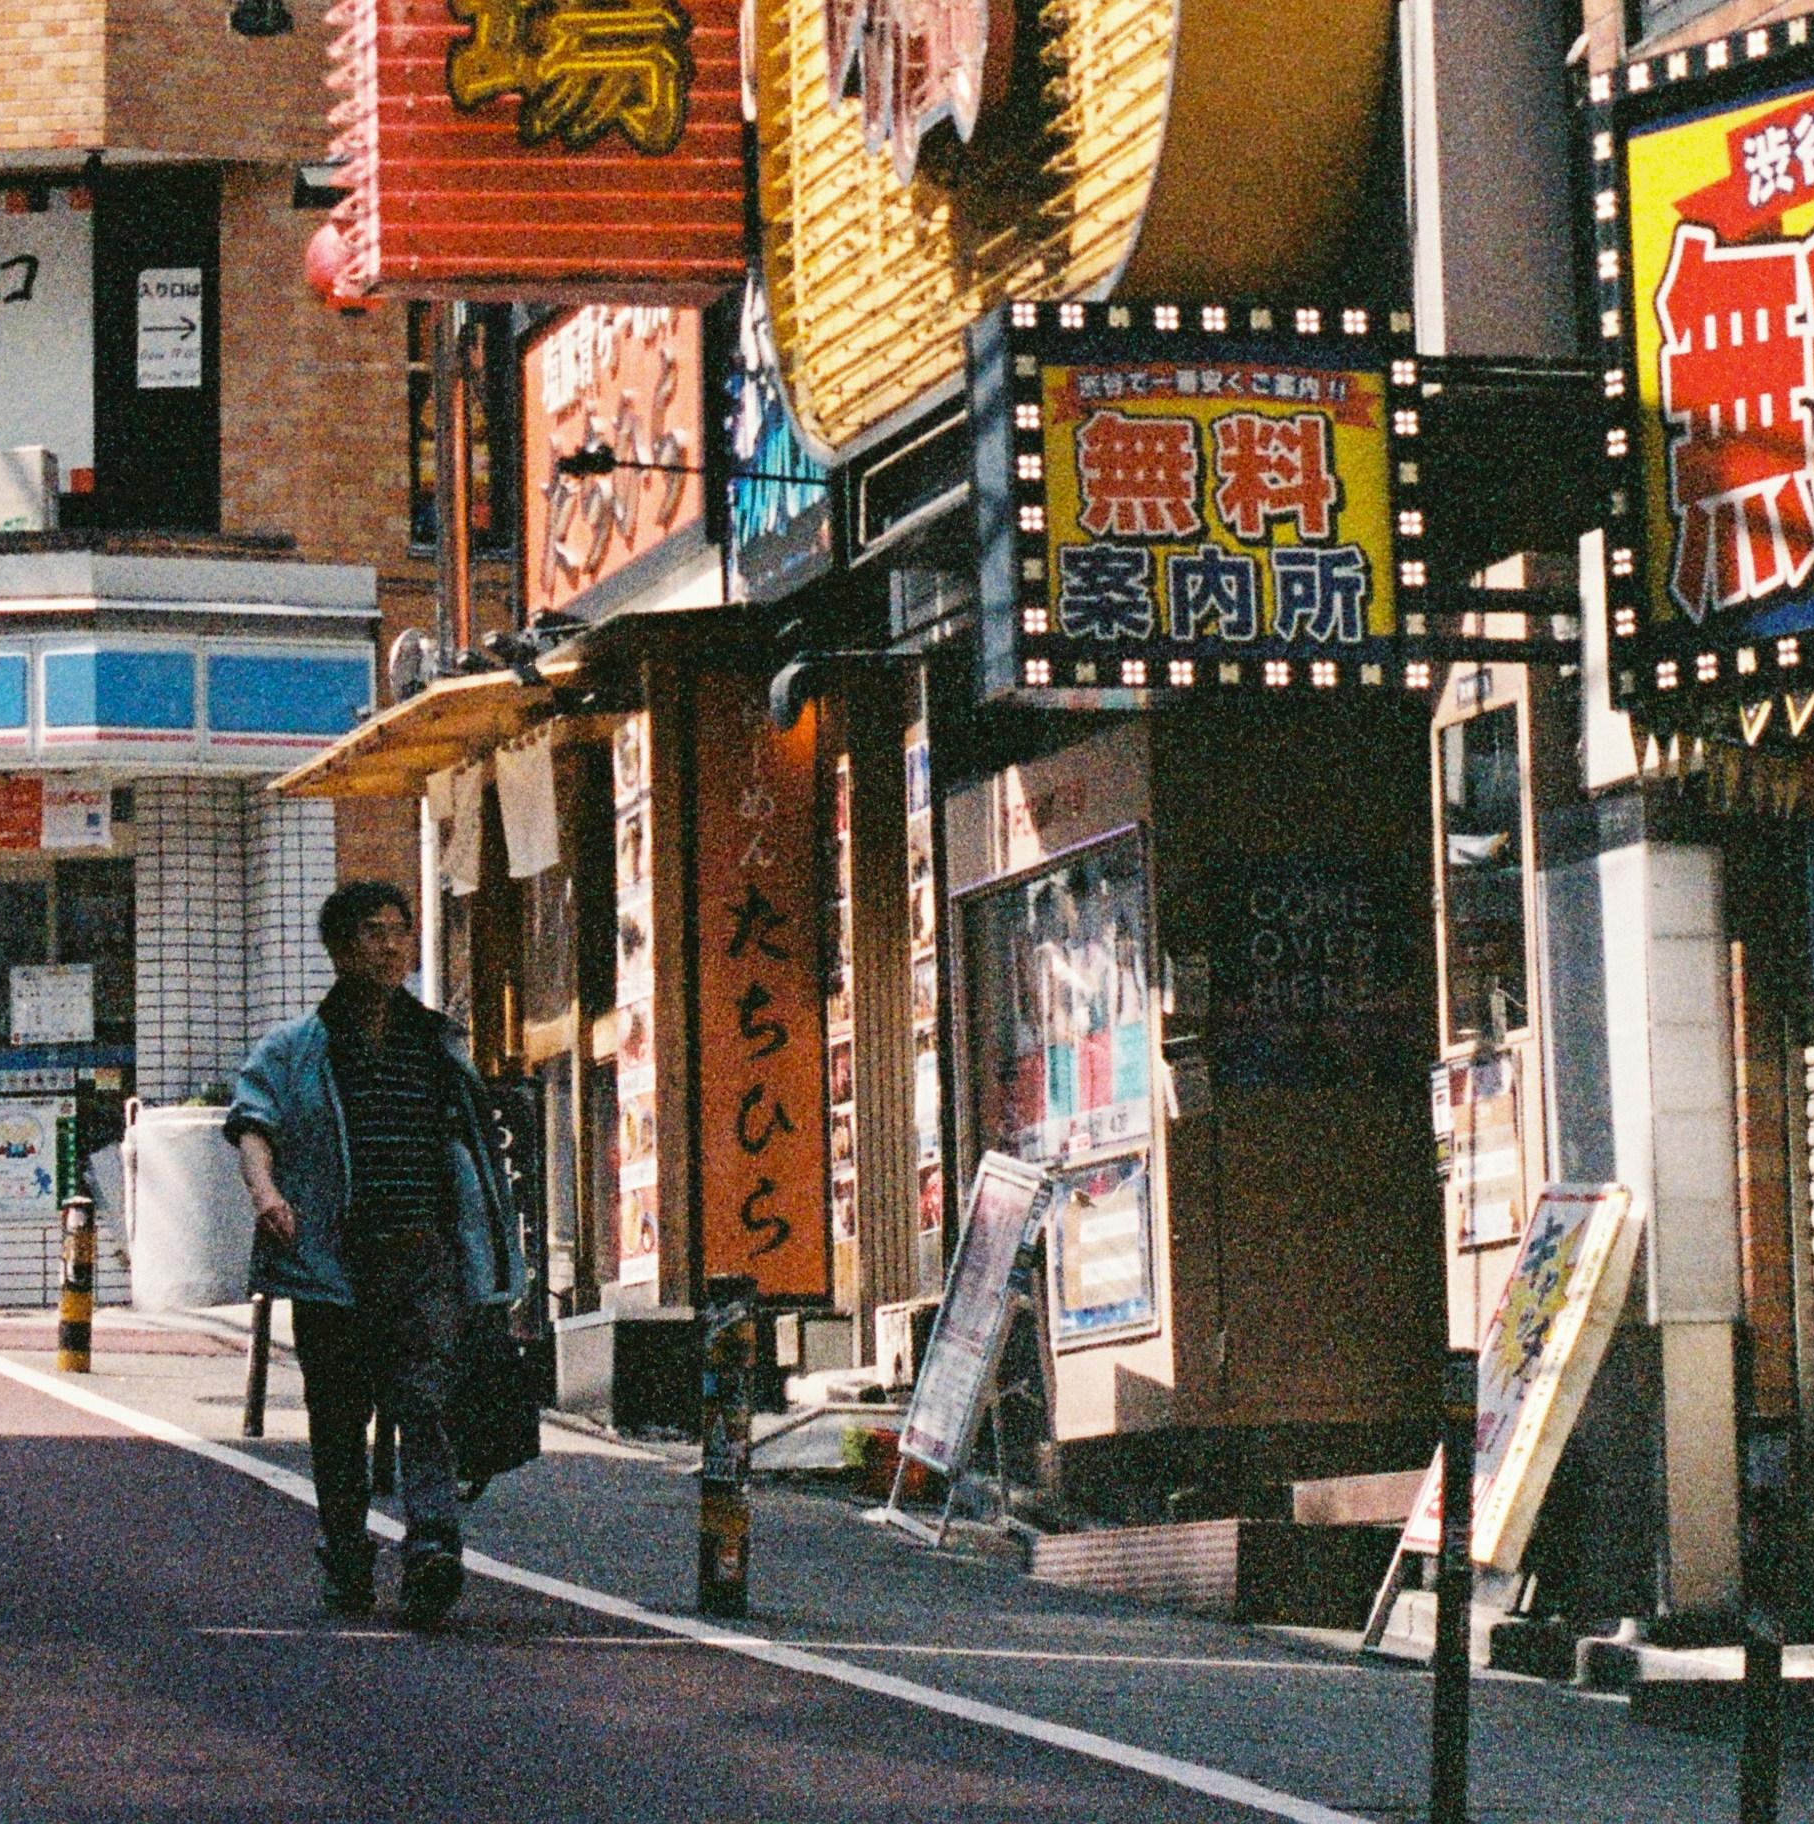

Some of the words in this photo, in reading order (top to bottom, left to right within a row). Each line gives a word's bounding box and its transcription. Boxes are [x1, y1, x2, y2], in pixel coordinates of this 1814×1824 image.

[1075, 409, 1339, 542] 無料
[1057, 543, 1369, 643] 案内所
[728, 885, 797, 1257] たちひら
